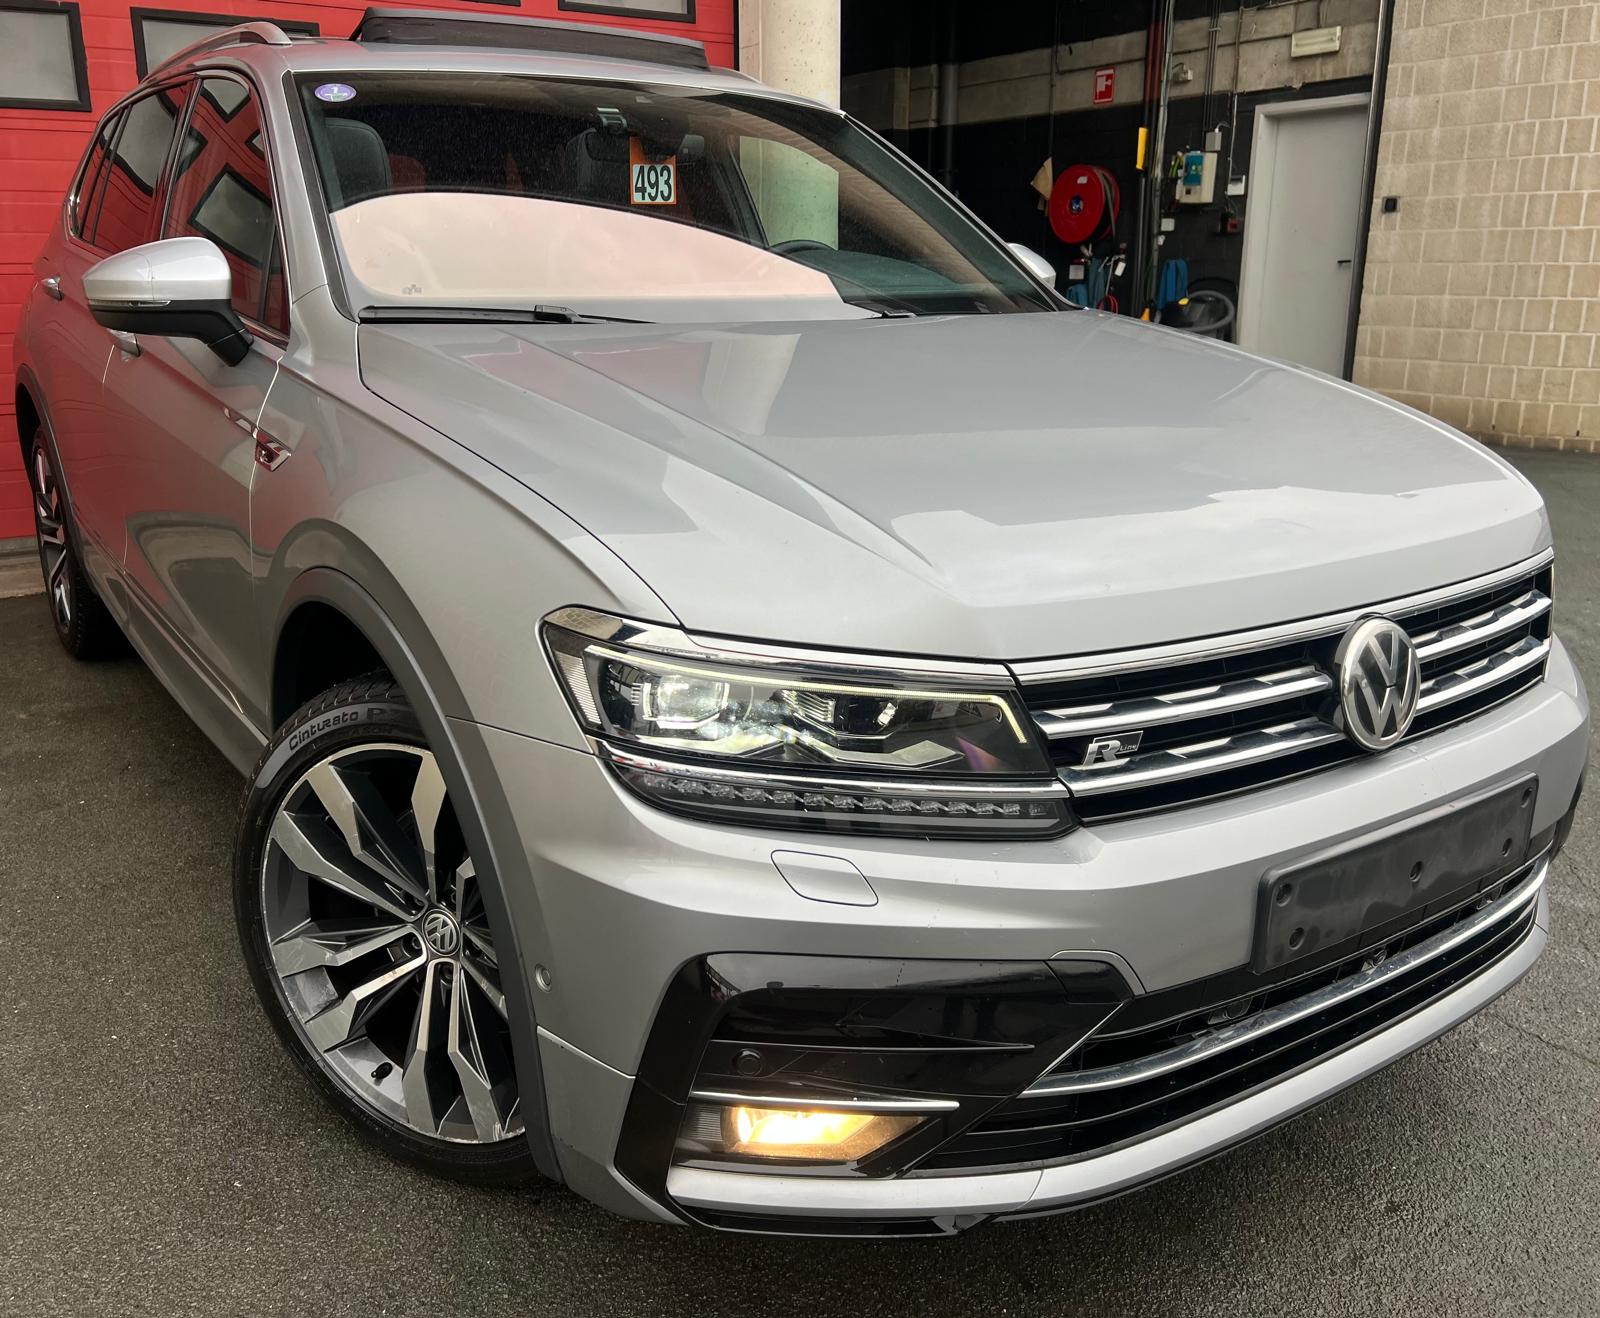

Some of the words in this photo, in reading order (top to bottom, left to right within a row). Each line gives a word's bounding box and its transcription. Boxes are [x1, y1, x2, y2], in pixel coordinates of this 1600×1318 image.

[634, 164, 673, 202] 493
[1343, 618, 1419, 745] VW
[289, 711, 359, 751] Cinturato
[1082, 740, 1121, 767] R
[425, 914, 457, 953] VW
